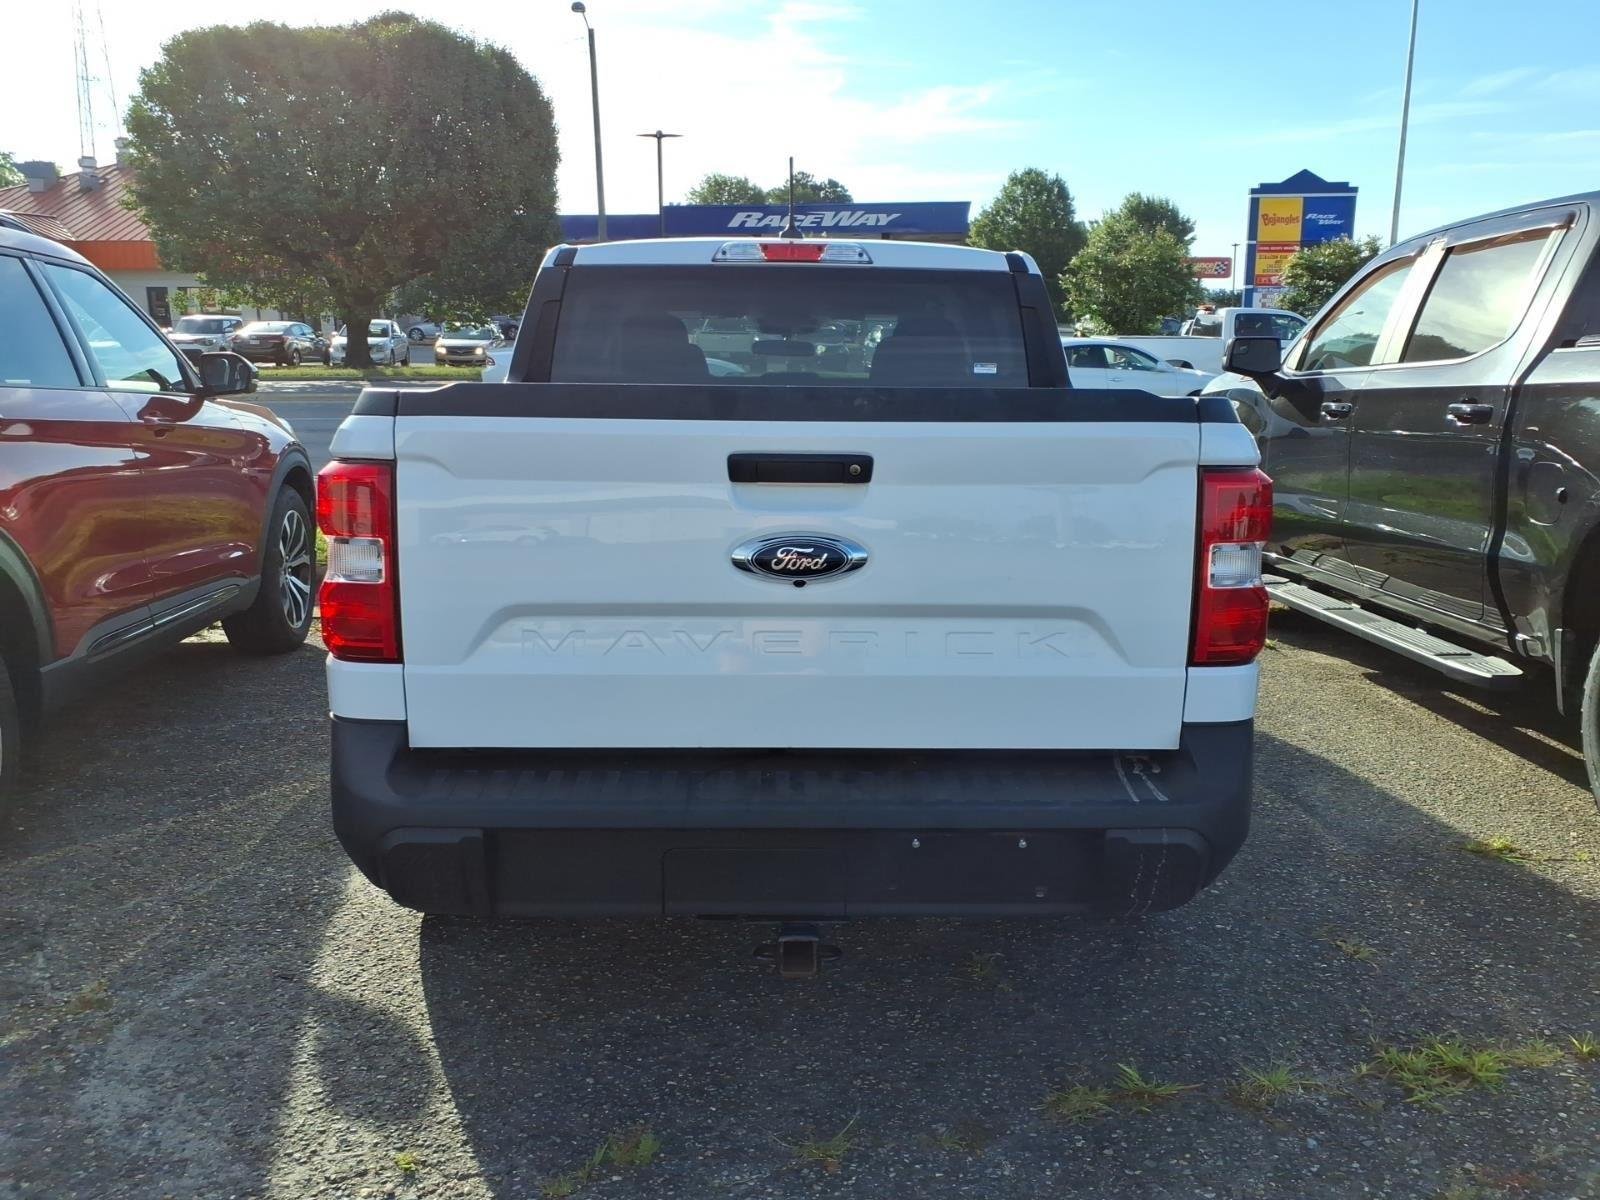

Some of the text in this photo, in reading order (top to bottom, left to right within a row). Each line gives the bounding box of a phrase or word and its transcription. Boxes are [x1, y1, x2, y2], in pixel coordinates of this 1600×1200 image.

[1261, 213, 1300, 226] Bojangles
[771, 546, 827, 571] Ford
[521, 629, 1071, 658] MAVERICK
